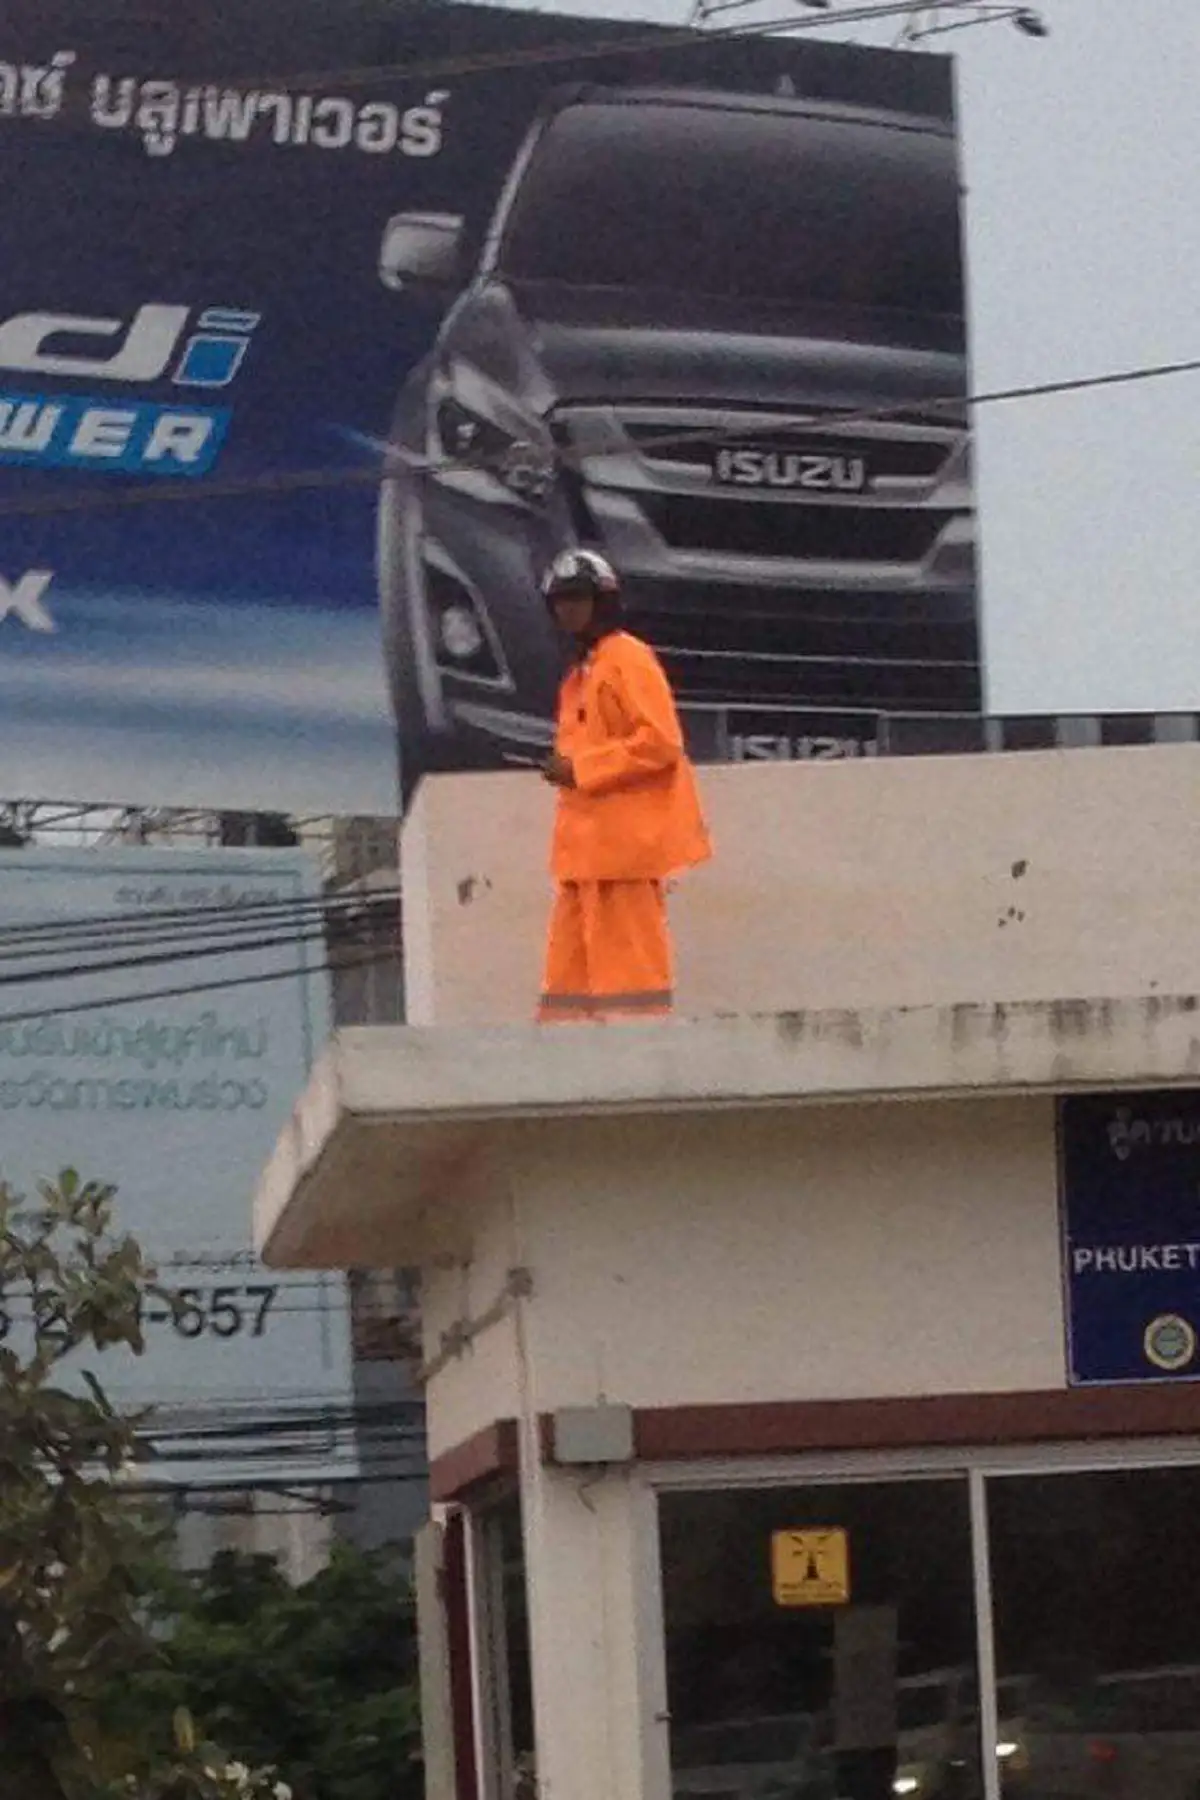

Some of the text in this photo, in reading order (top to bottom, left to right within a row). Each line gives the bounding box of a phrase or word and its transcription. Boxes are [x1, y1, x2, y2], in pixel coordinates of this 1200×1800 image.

[92, 74, 449, 158] บลูเพาเวอร์
[0, 402, 214, 463] WER
[717, 449, 864, 489] ISUZU
[1073, 1244, 1200, 1274] PHUKET
